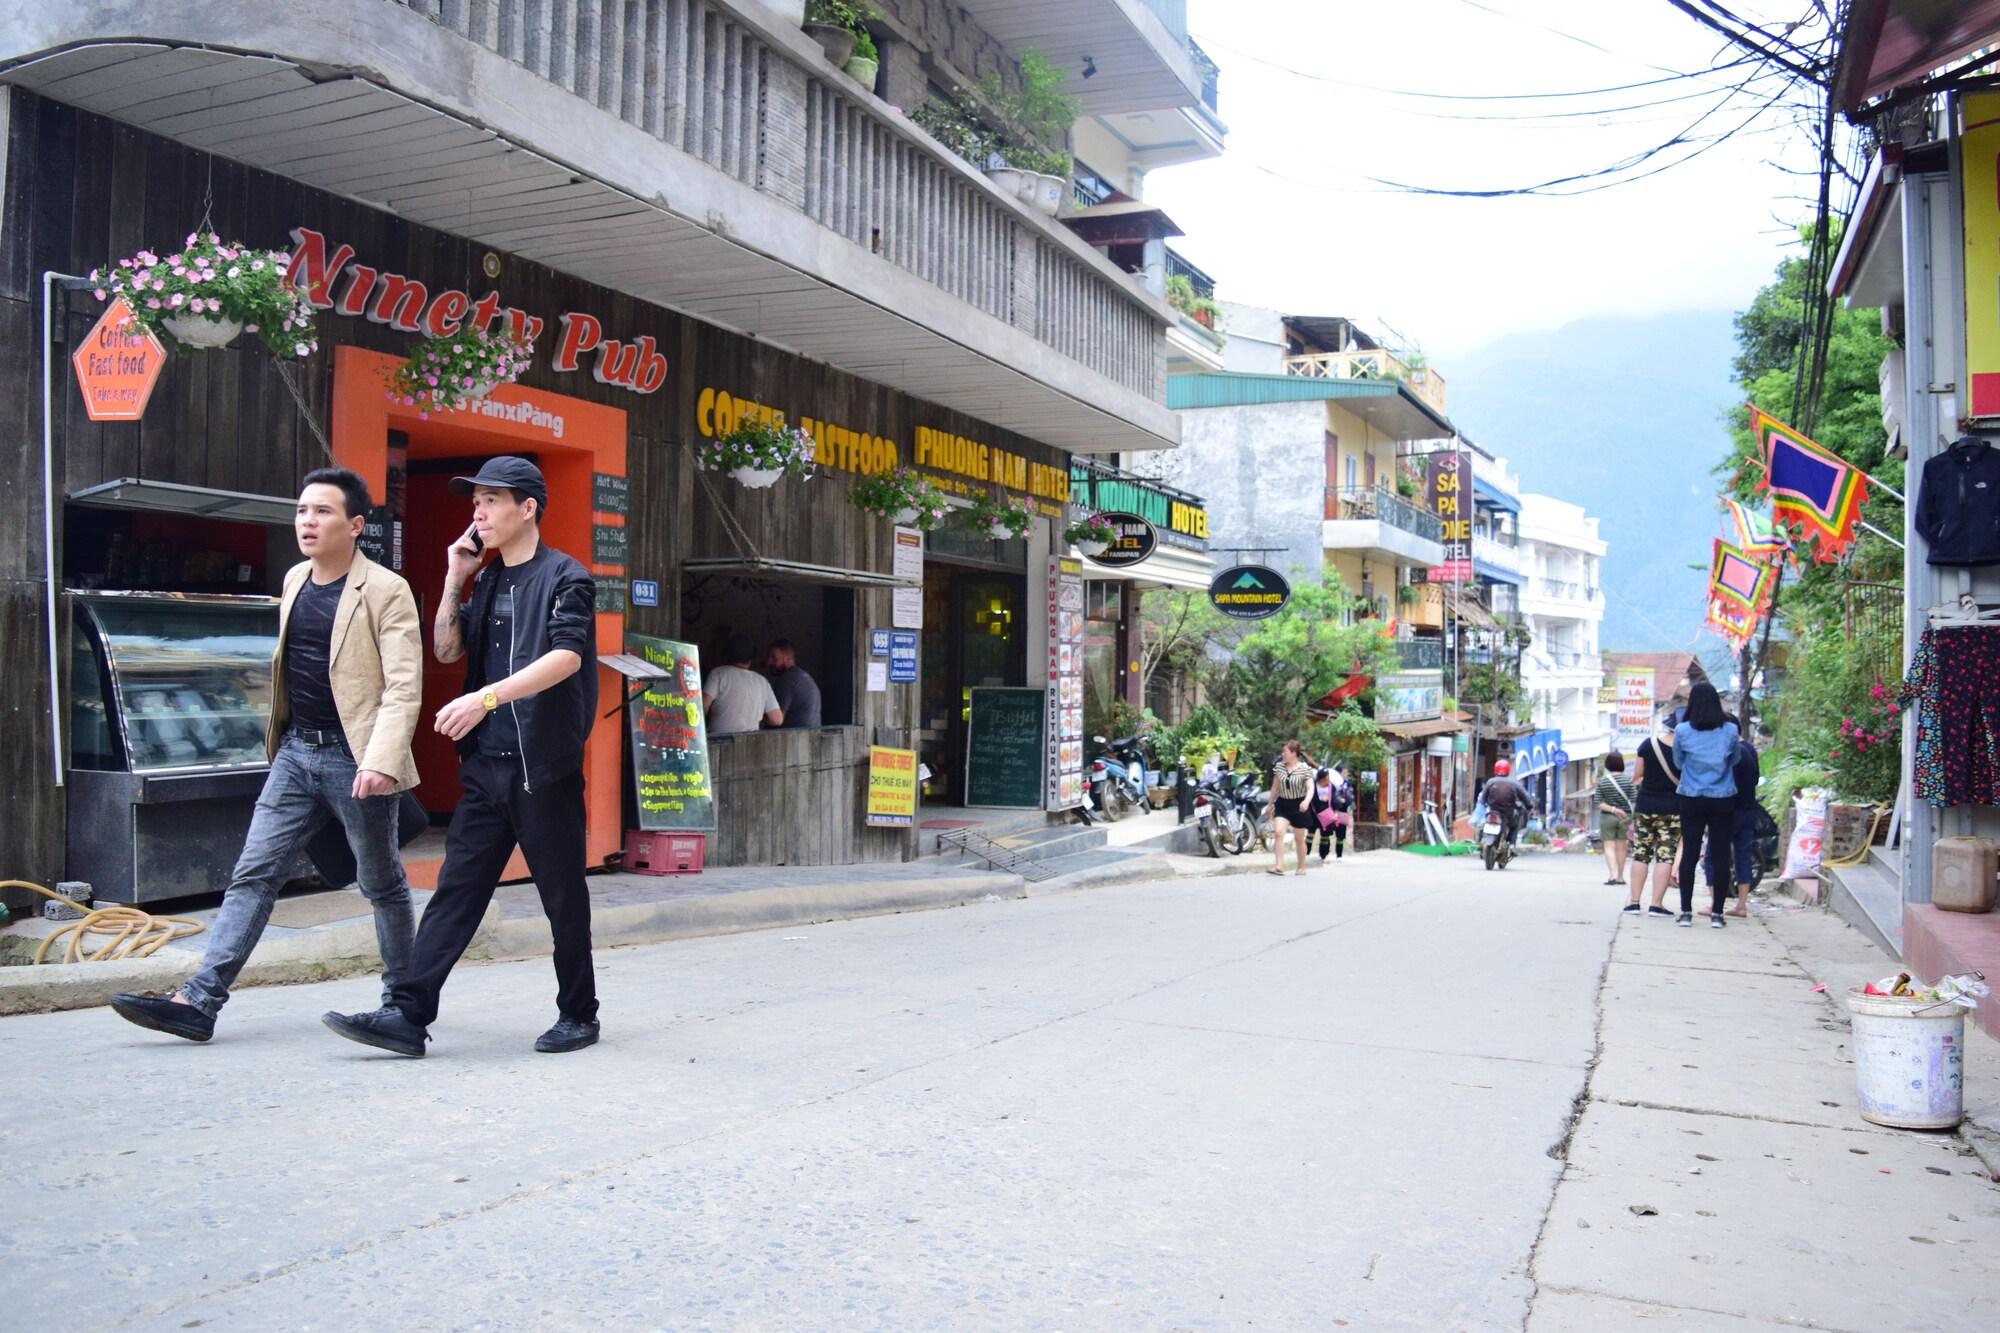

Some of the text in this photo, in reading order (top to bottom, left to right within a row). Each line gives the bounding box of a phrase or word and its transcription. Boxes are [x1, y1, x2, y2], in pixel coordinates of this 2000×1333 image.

[554, 311, 668, 394] Pub
[89, 351, 146, 376] Fast food
[989, 447, 1027, 492] NAM
[1028, 461, 1070, 503] HOTEL
[1436, 473, 1461, 492] SA
[1438, 496, 1460, 515] PA
[1124, 523, 1147, 536] NAM
[1171, 500, 1211, 539] HOTEL
[1441, 519, 1470, 540] OME
[634, 582, 655, 598] 031
[1263, 593, 1283, 604] HOTEL
[1049, 687, 1057, 801] RESTAURANT
